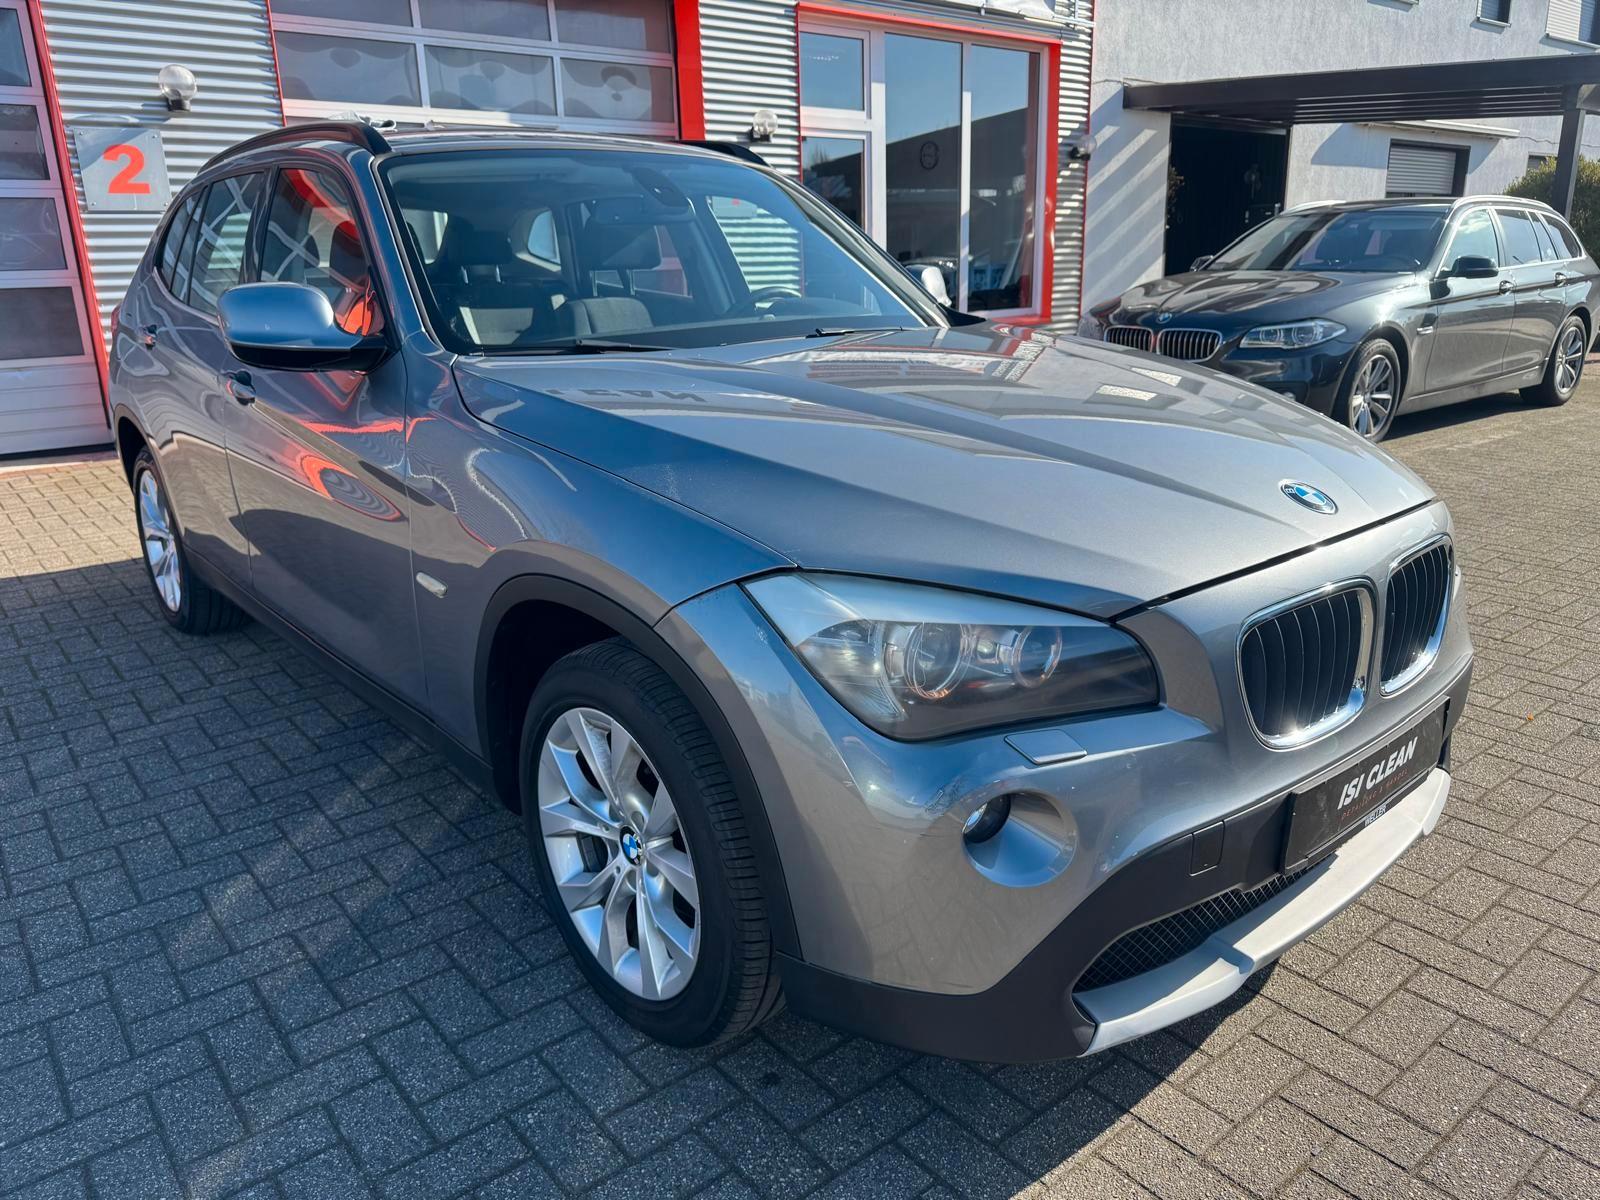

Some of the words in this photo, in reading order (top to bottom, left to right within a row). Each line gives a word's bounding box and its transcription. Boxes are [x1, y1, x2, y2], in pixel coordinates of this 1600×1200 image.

[103, 143, 151, 194] 2
[1337, 773, 1365, 810] ISI
[1366, 736, 1418, 789] CLEAN
